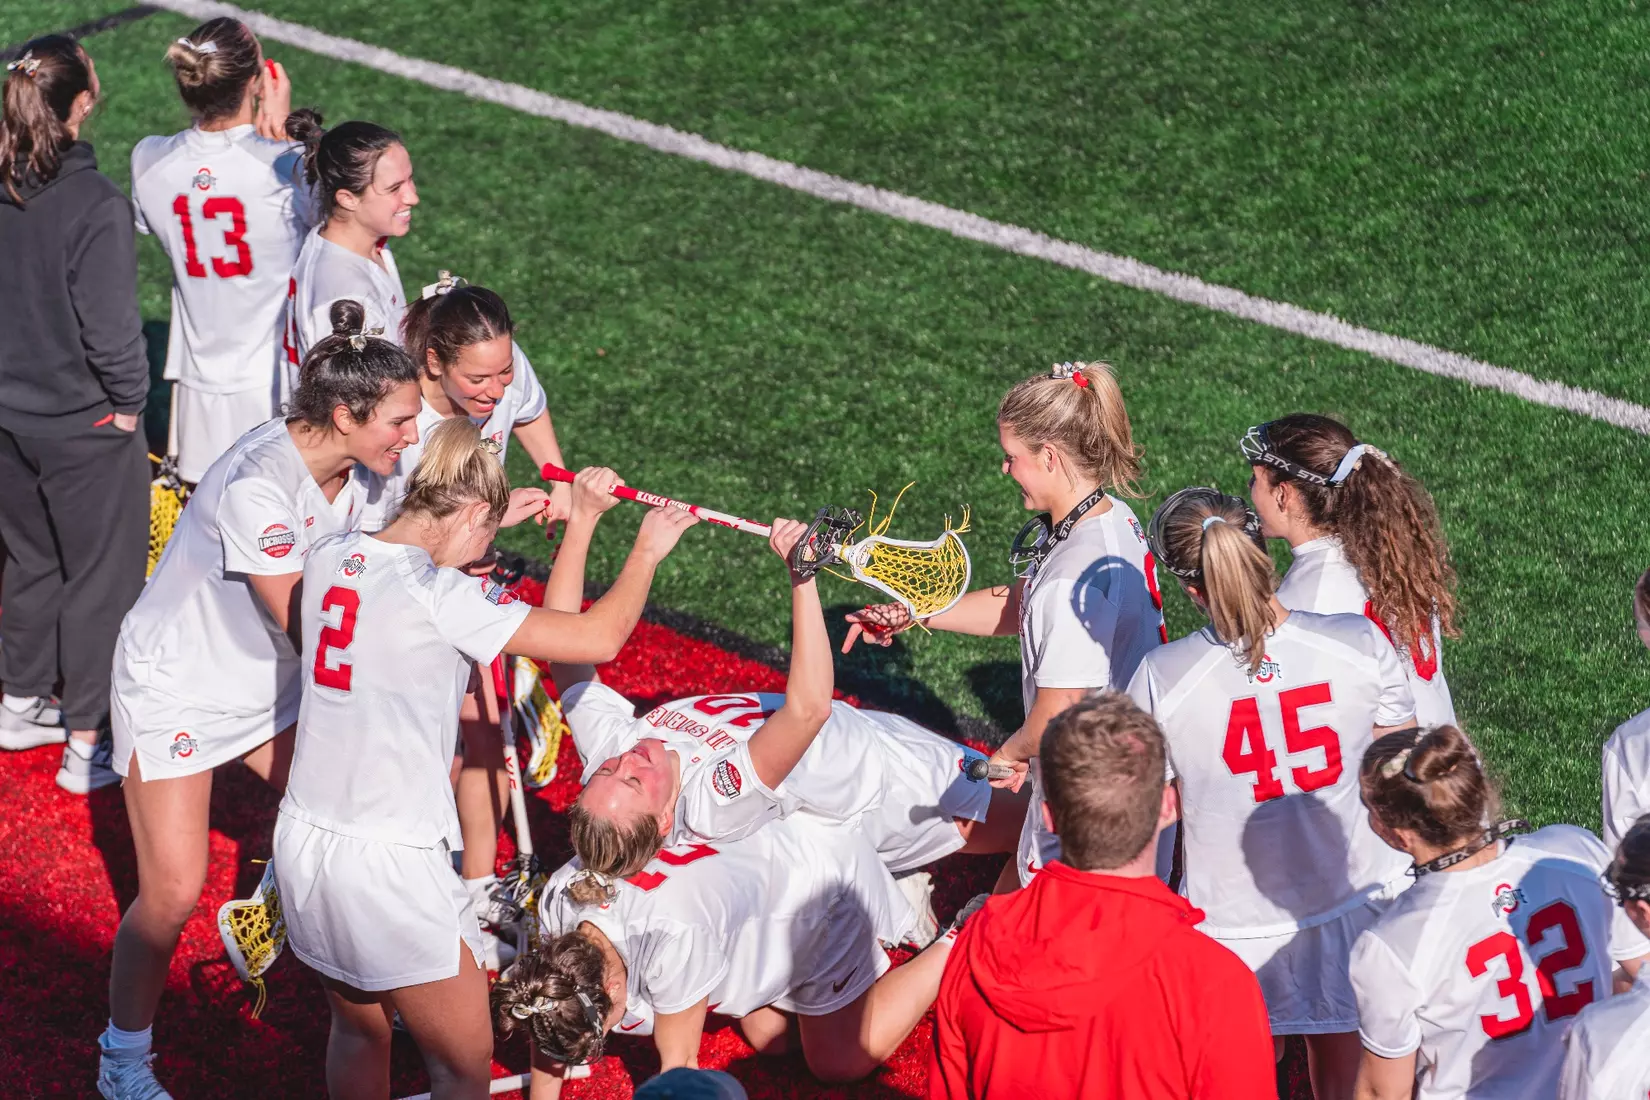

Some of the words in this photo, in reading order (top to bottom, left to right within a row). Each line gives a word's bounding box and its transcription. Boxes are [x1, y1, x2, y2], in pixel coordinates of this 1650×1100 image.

[172, 193, 255, 279] 13
[1264, 452, 1292, 472] STX
[1296, 469, 1328, 486] STX
[1077, 491, 1102, 515] STX
[313, 585, 362, 692] 2
[645, 705, 710, 739] STATE
[1222, 680, 1345, 804] 45
[1437, 847, 1471, 869] STX
[1498, 818, 1524, 834] ST
[1465, 899, 1595, 1041] 32
